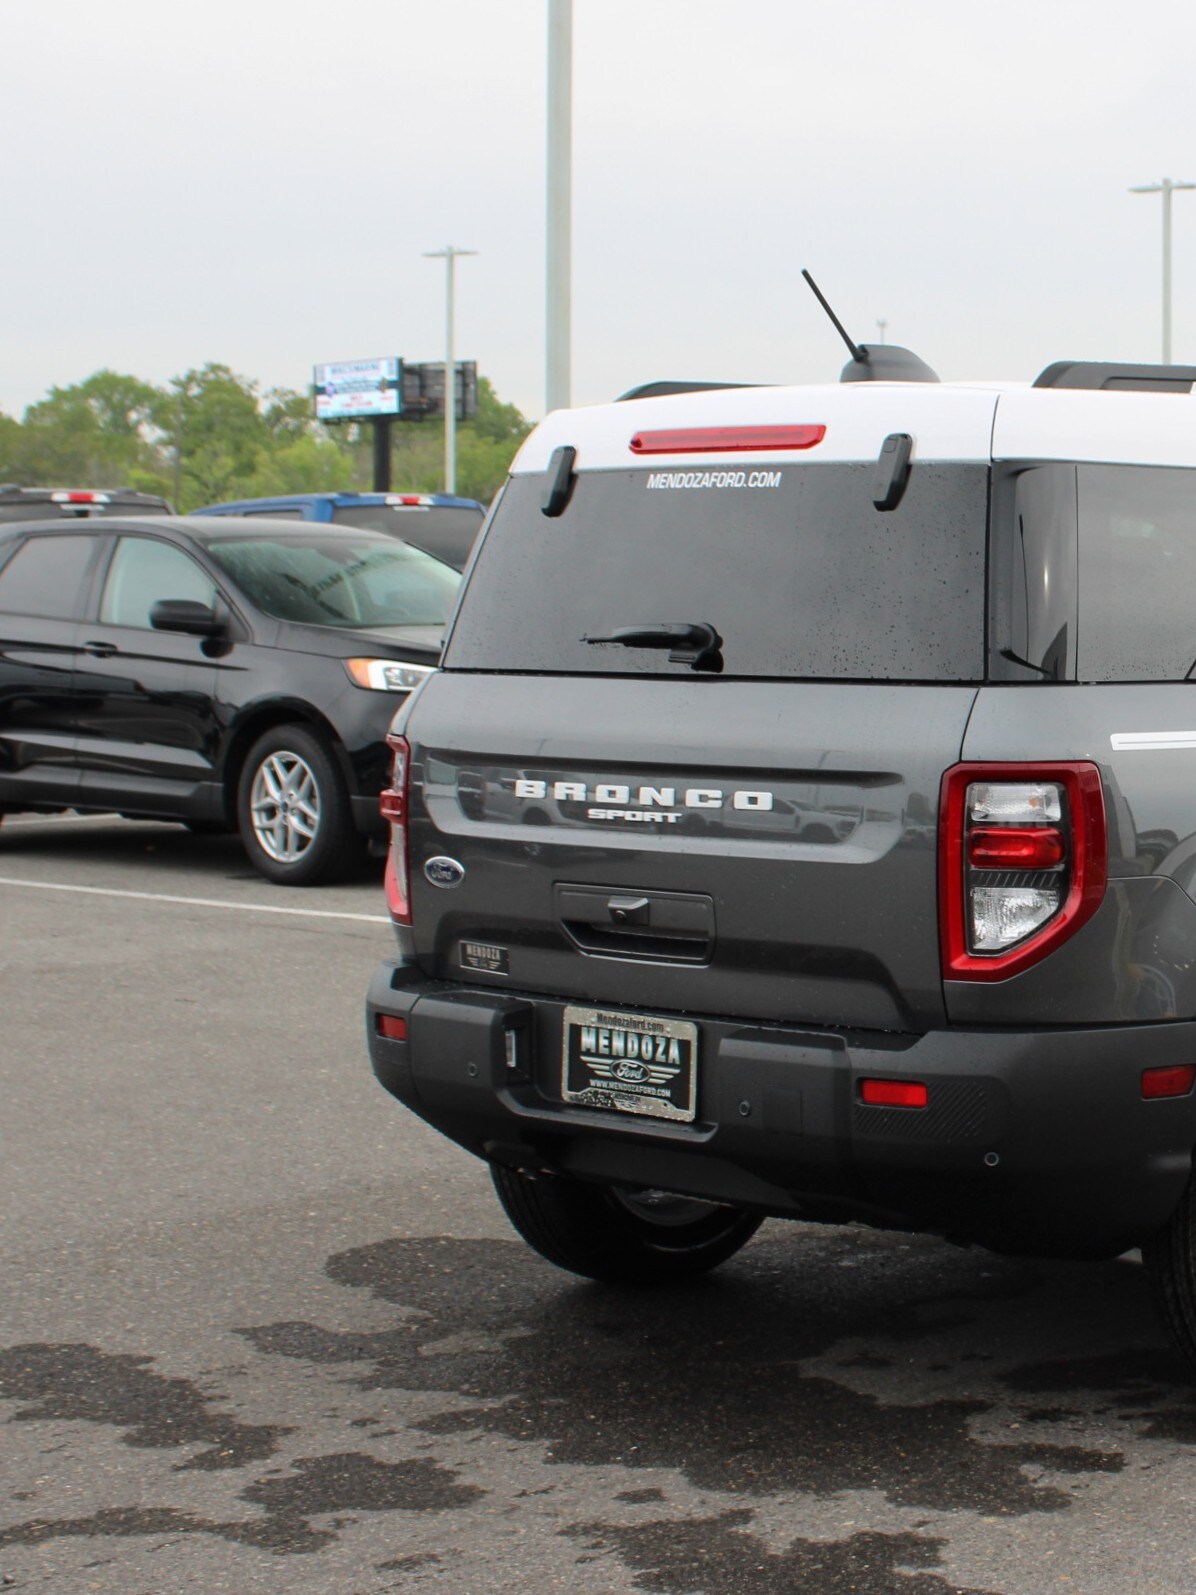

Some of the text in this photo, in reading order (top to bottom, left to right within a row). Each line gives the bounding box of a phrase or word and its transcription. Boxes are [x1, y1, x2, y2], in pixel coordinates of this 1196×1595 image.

[646, 471, 782, 489] MENDOZAFORD.COM
[514, 779, 774, 811] BRONCO
[587, 808, 682, 823] SPORT
[580, 1026, 681, 1065] MENDOZA
[616, 1062, 643, 1080] Ford
